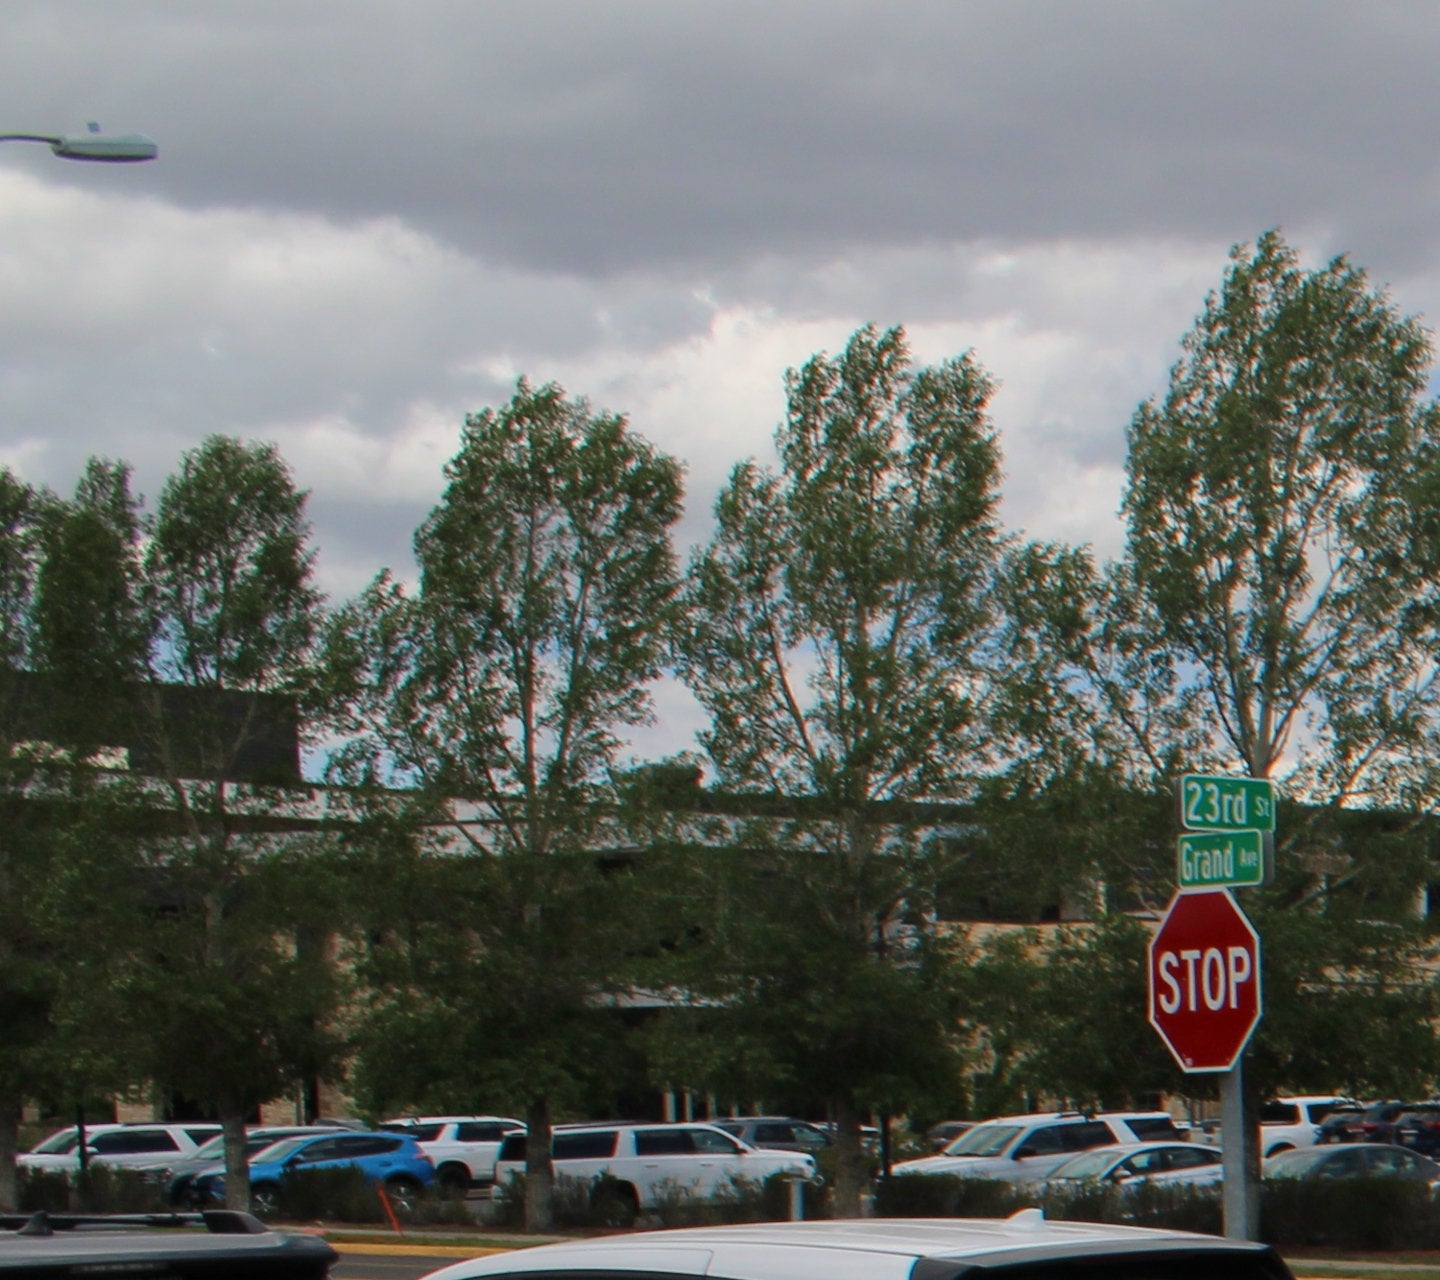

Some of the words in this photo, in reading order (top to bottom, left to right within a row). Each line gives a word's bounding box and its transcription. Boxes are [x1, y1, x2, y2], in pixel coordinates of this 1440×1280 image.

[1186, 781, 1247, 825] 23rd
[1255, 796, 1270, 817] St
[1181, 840, 1235, 881] Grand
[1159, 946, 1251, 1014] STOP
